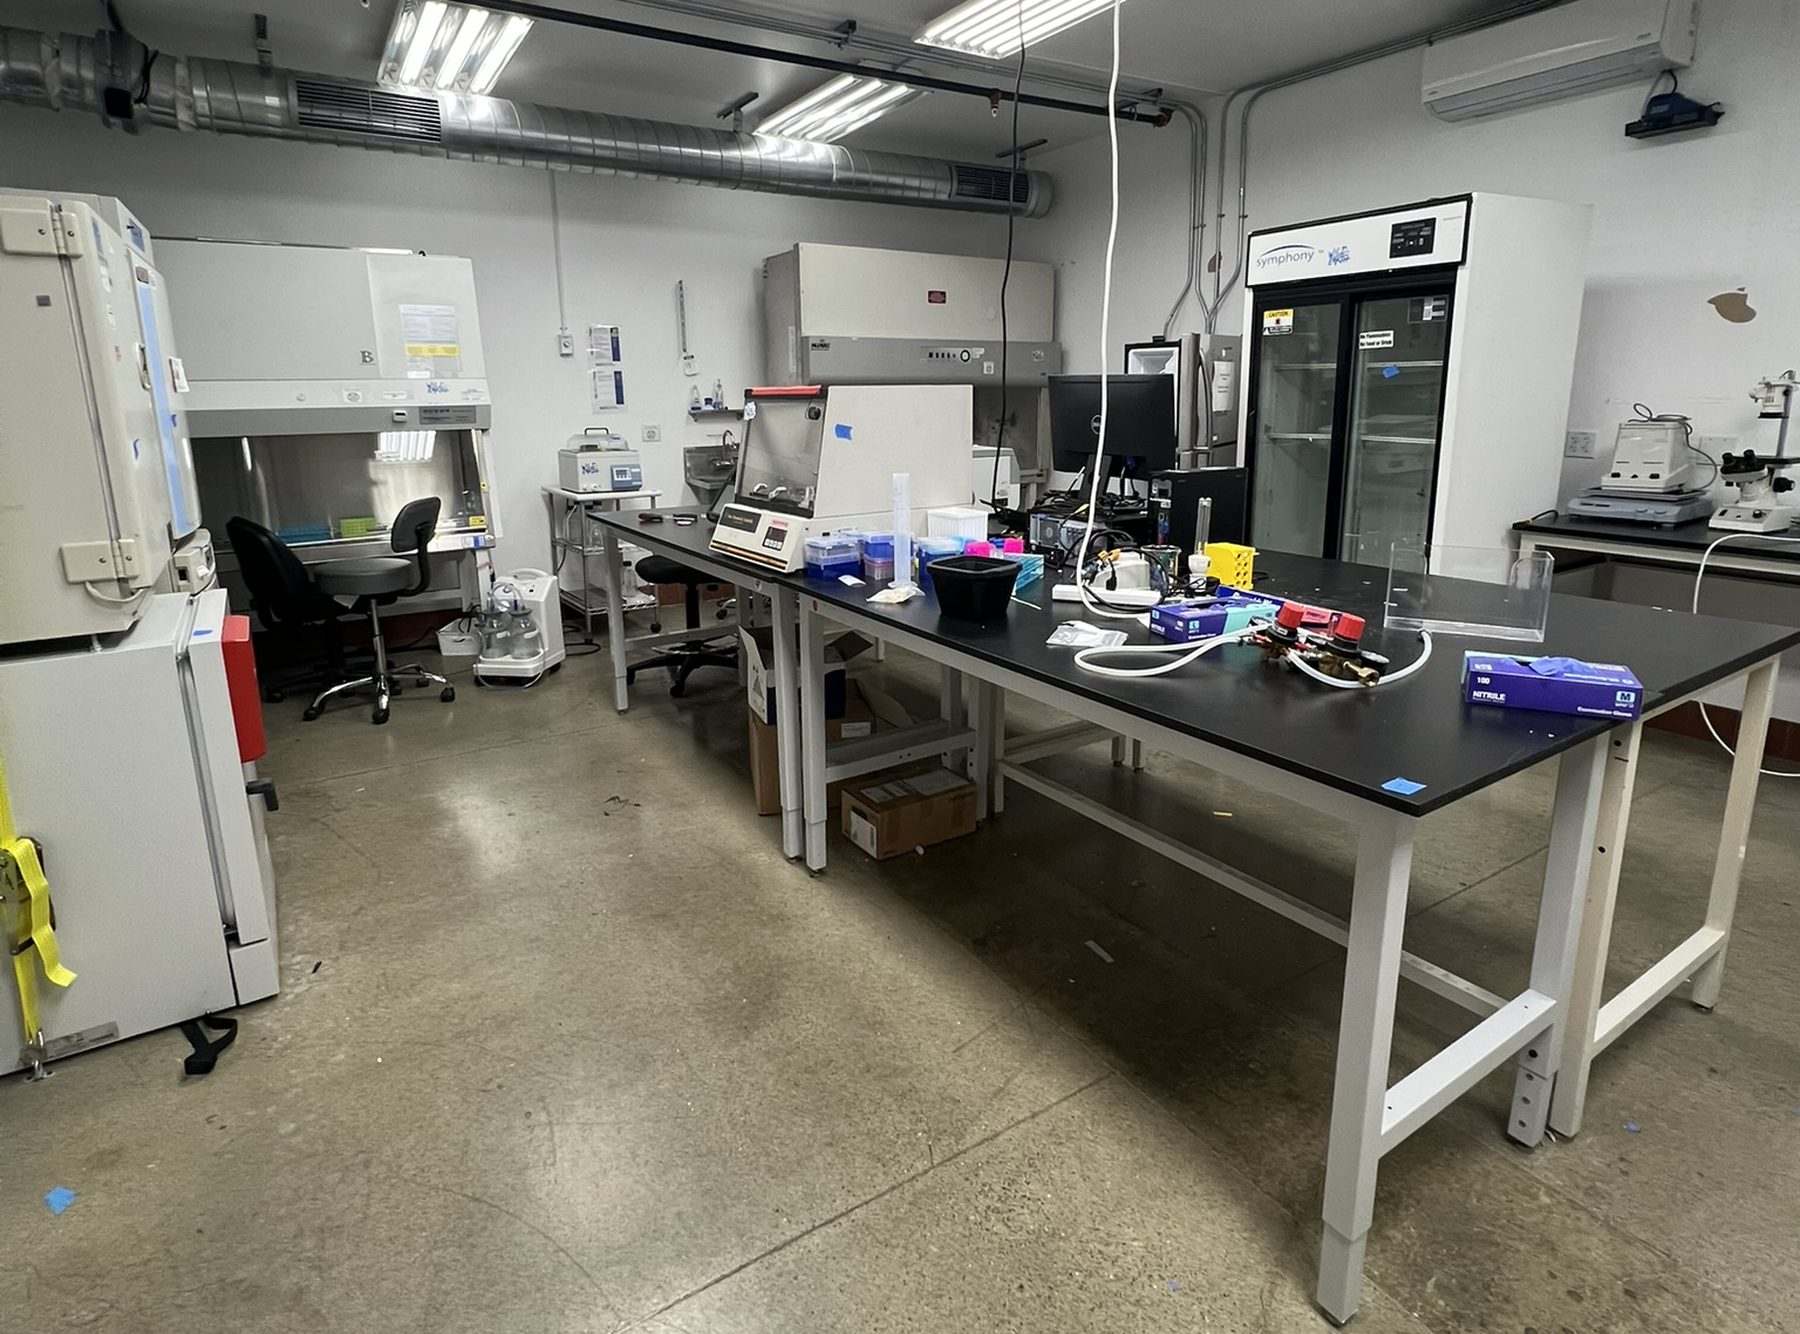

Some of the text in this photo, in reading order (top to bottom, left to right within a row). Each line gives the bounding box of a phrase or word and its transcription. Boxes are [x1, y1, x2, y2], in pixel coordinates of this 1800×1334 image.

[1256, 251, 1314, 268] symphony
[1477, 676, 1490, 684] 100
[1473, 691, 1506, 700] NITRILE
[1620, 692, 1631, 702] M
